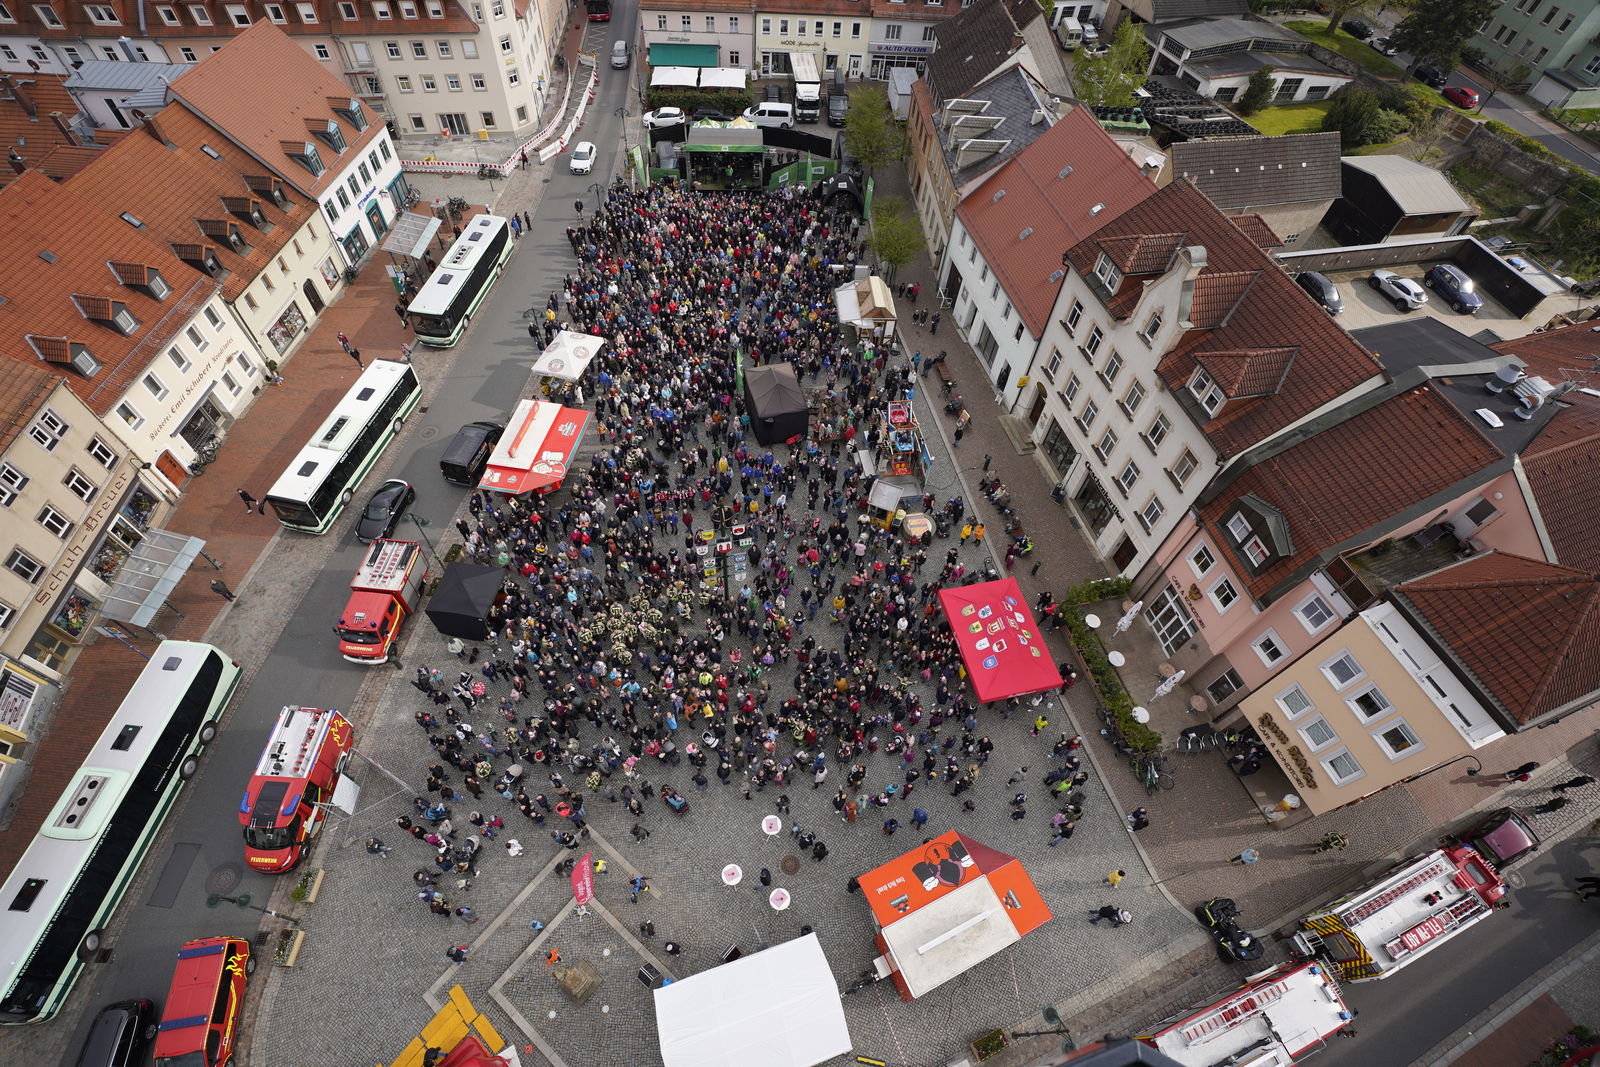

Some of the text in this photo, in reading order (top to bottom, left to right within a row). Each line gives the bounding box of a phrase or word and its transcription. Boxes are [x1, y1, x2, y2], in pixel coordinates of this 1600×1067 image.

[171, 395, 186, 414] Emil
[185, 362, 212, 396] Schubert
[1085, 461, 1125, 523] Geschenkartikel
[1275, 749, 1305, 789] KONDITOREI
[19, 923, 54, 976] REGIONALVERKEHR
[52, 893, 71, 922] Sächsische
[102, 823, 113, 839] GmbH
[1403, 933, 1420, 948] 491
